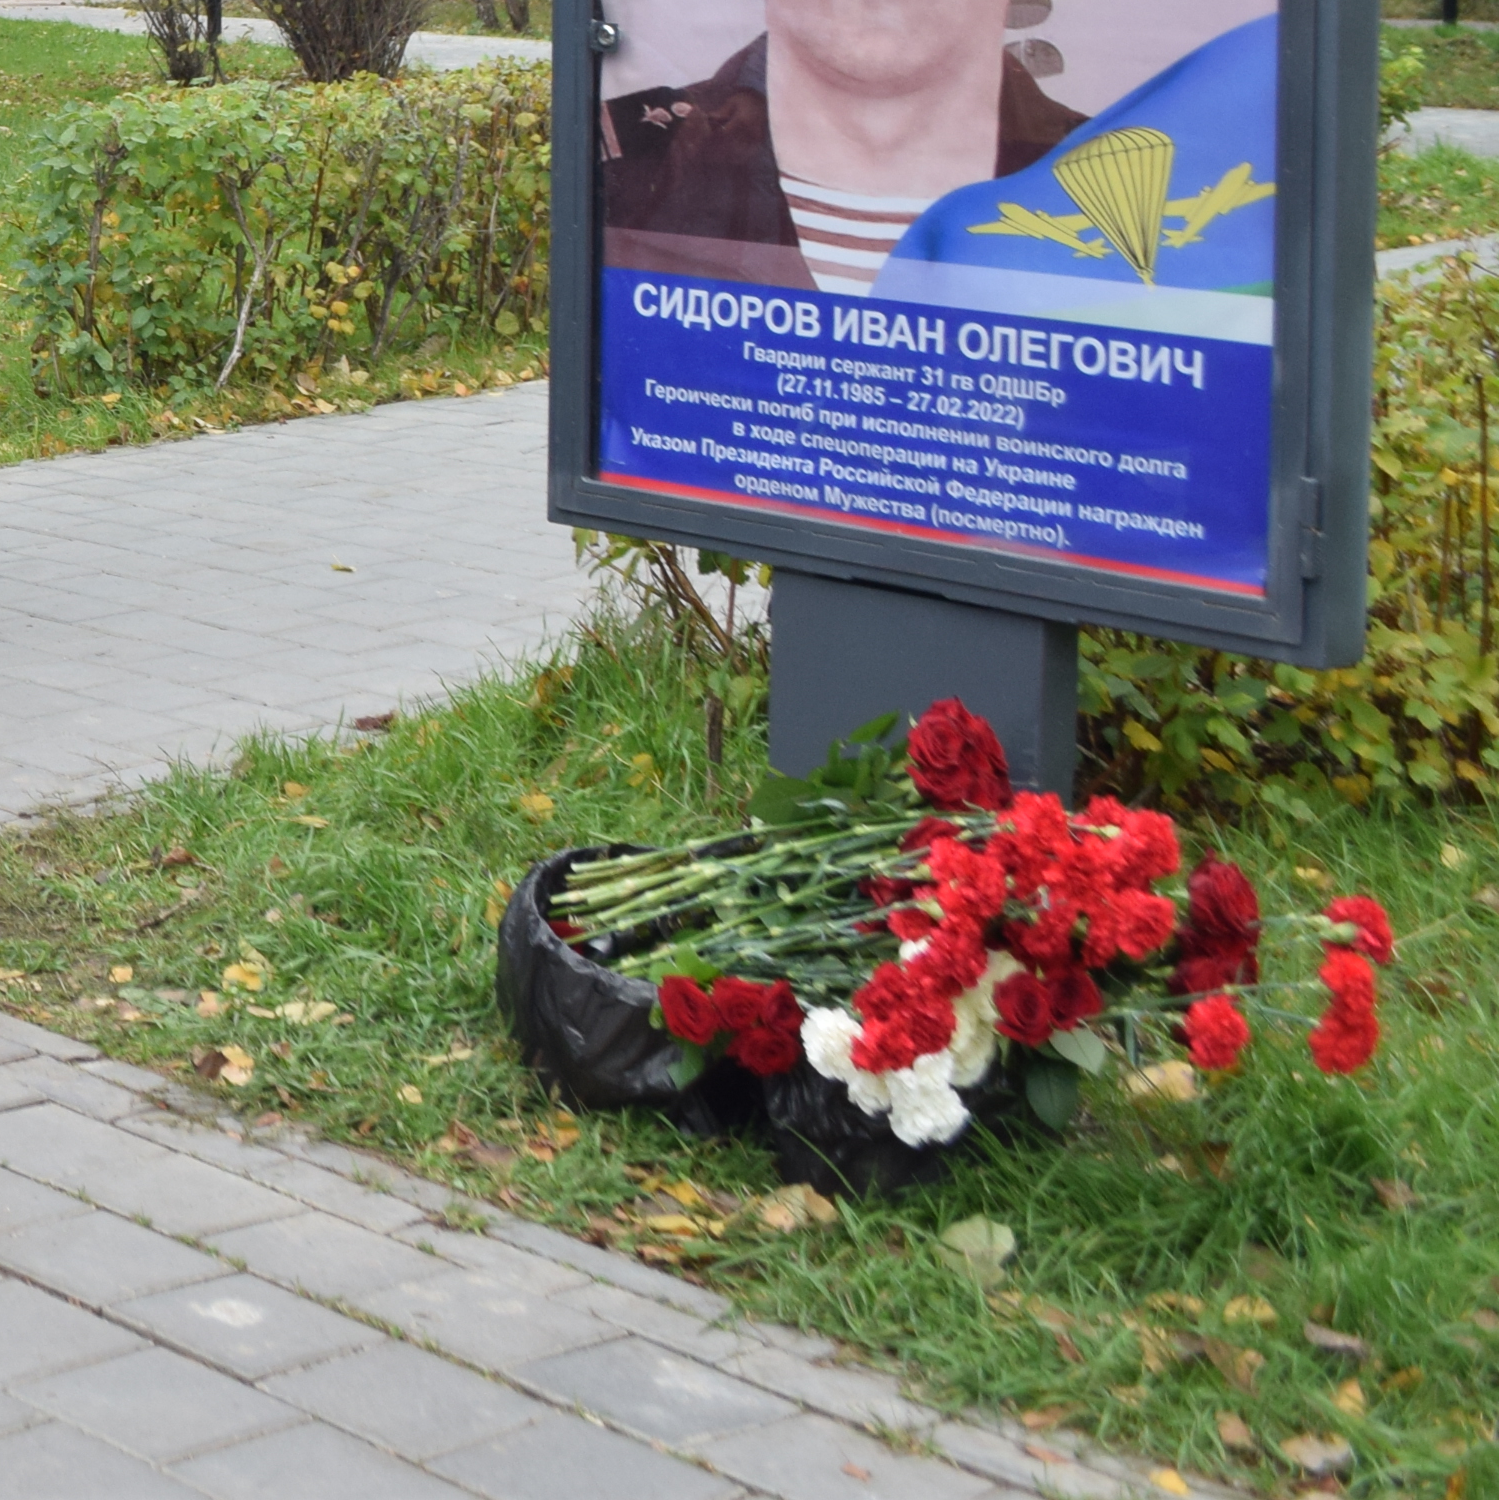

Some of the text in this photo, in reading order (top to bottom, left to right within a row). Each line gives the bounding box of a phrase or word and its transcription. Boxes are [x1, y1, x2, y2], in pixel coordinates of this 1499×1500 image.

[633, 282, 1205, 390] СИДОРОВ ИВАН ОЛЕГОВИЧ
[743, 341, 1067, 408] Гвардии сержант 31 гв ОДШБр
[777, 373, 885, 405] (27.11.1985
[907, 391, 1025, 431] 27.02.2022)
[645, 378, 1188, 480] Героически погиб при исполнении воинского долга
[732, 421, 1076, 491] в ходе спецоперации на Украине
[631, 425, 1205, 540] Указом Президента Российской Федерации награжден
[734, 472, 1070, 548] орденом Мужества (посмертно).
